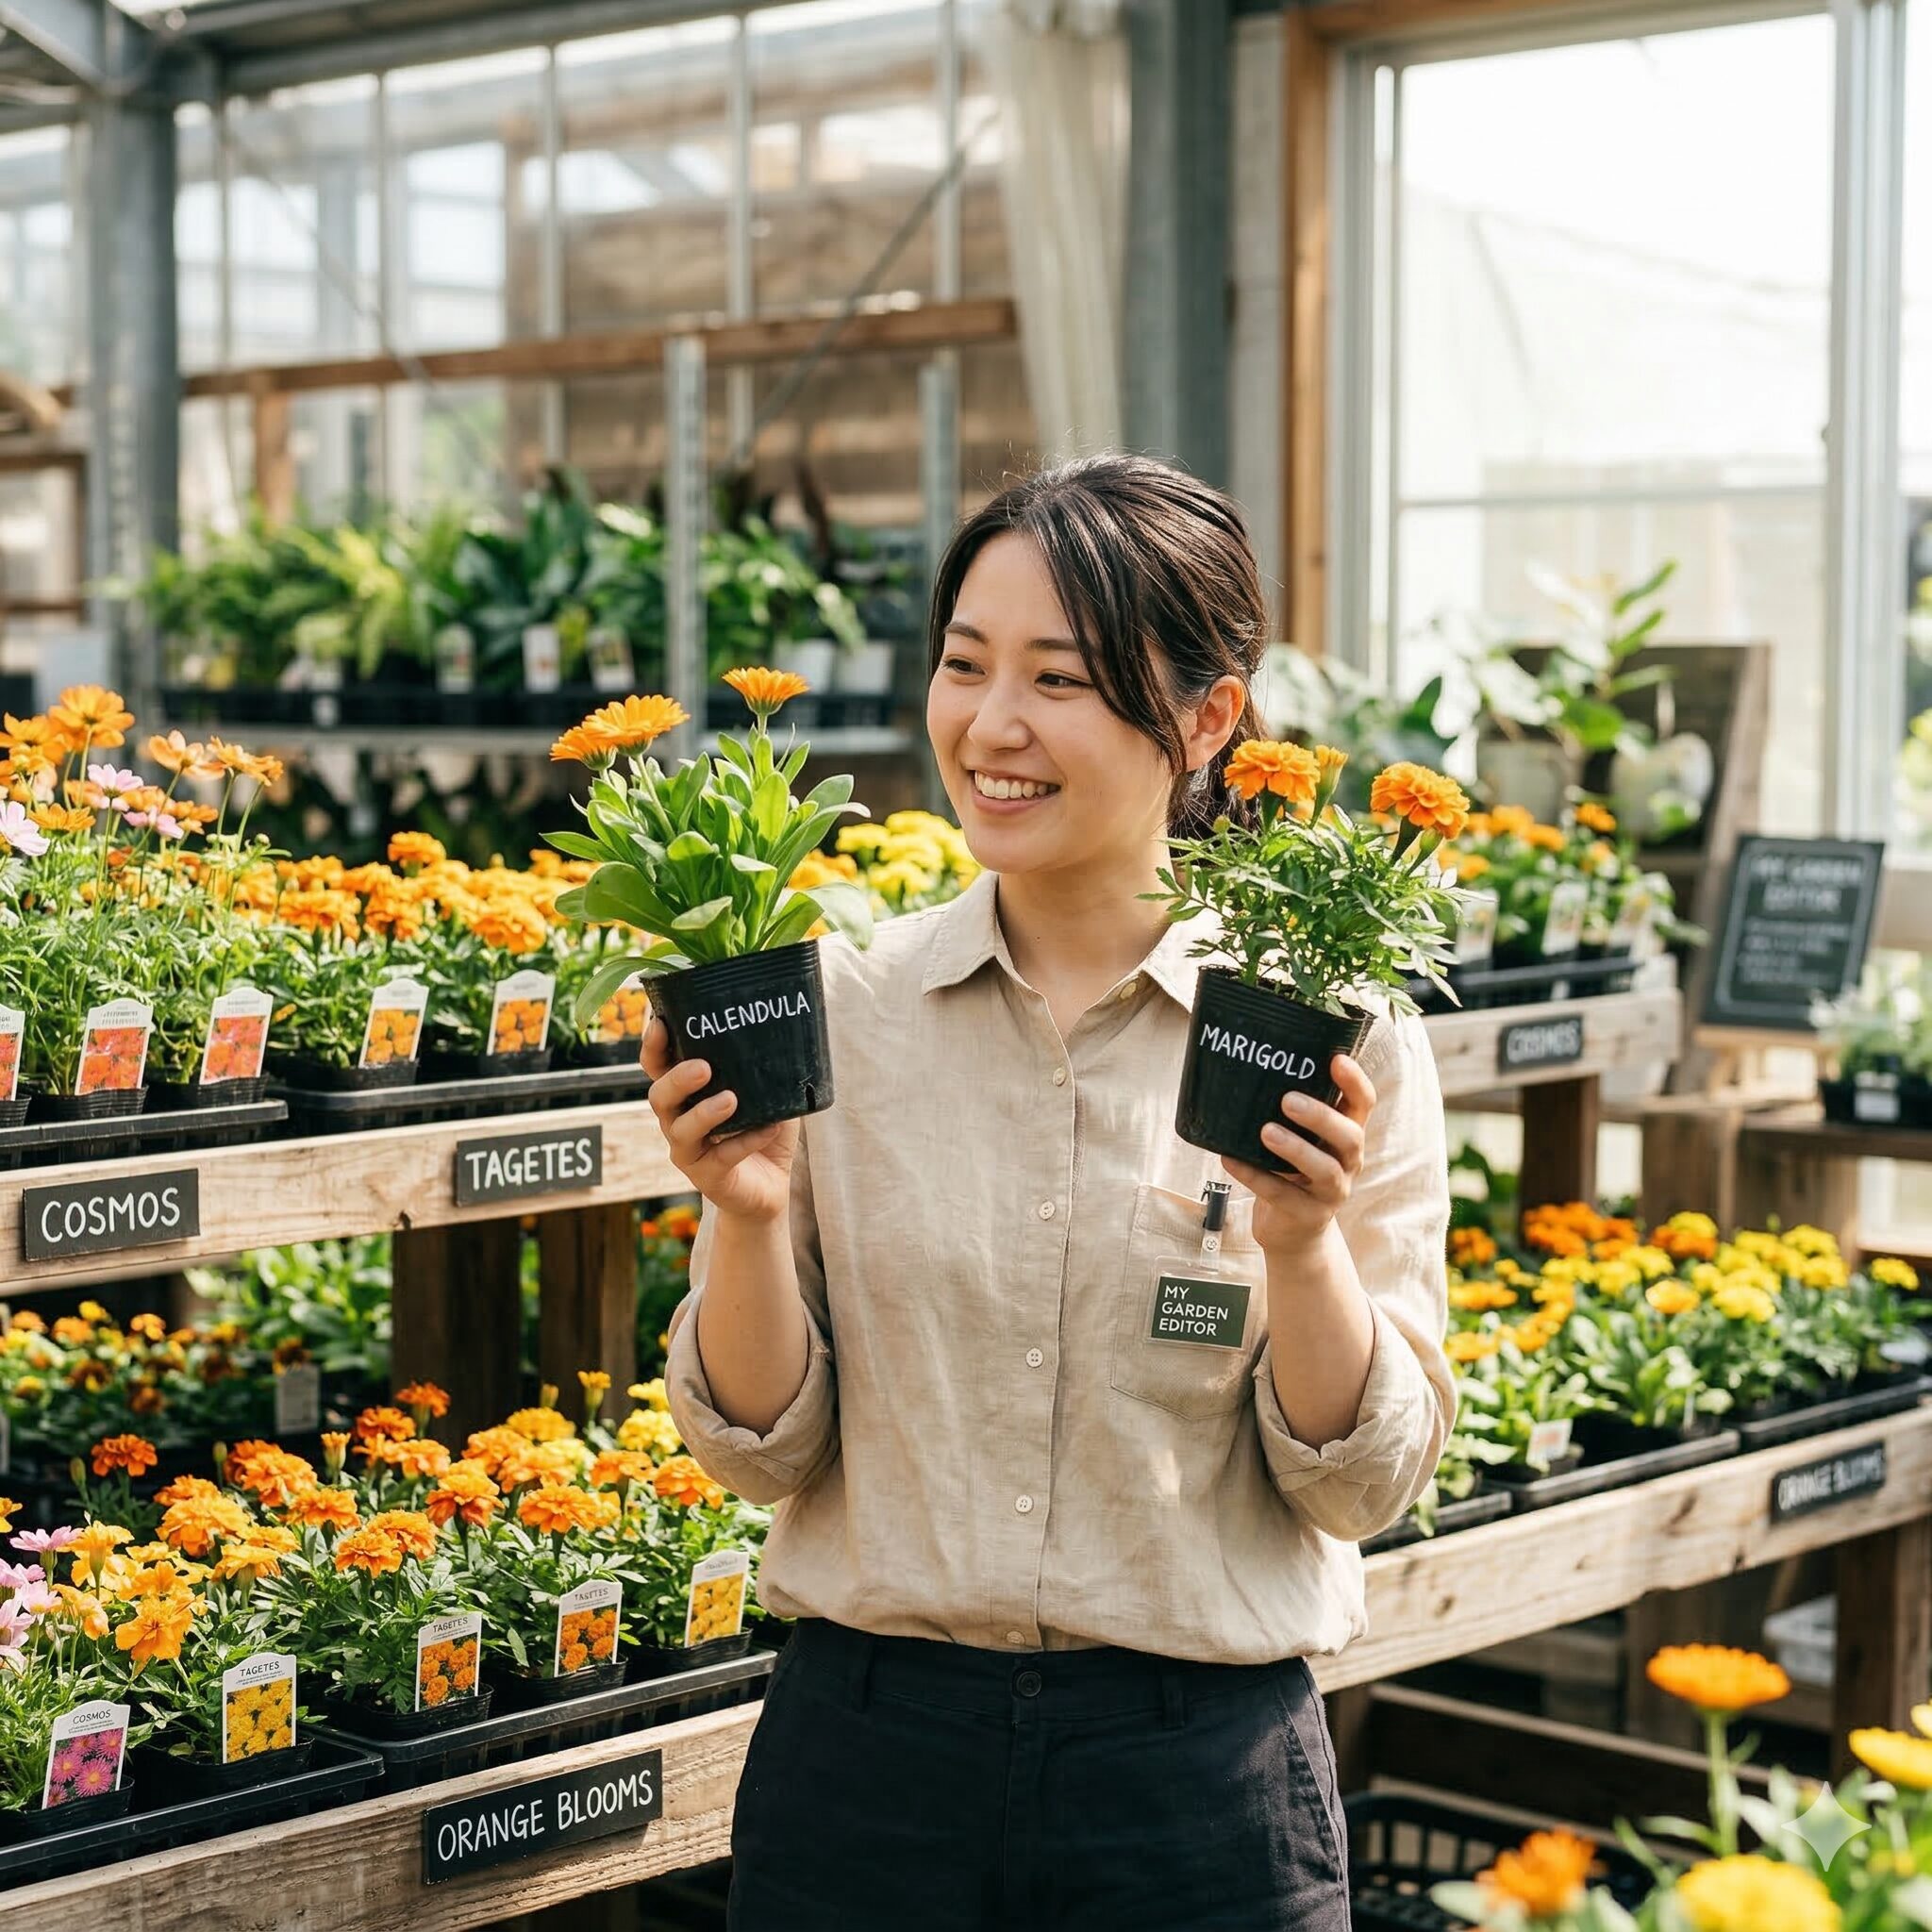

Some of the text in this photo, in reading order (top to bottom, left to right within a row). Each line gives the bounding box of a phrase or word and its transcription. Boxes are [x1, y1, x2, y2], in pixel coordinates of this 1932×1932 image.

[686, 991, 811, 1040] CALENDULA
[1199, 1023, 1316, 1080] MARIGOLD
[464, 1137, 593, 1191] TAGETES
[41, 1187, 181, 1243] COSMOS
[1164, 1285, 1190, 1300] MY
[1161, 1301, 1229, 1321] GARDEN
[1158, 1318, 1217, 1337] EDITOR
[433, 1616, 469, 1633] TAGETES
[239, 1660, 280, 1677] TAGETES
[73, 1708, 111, 1724] COSMOS
[437, 1769, 654, 1861] ORANGE BLOOMS
